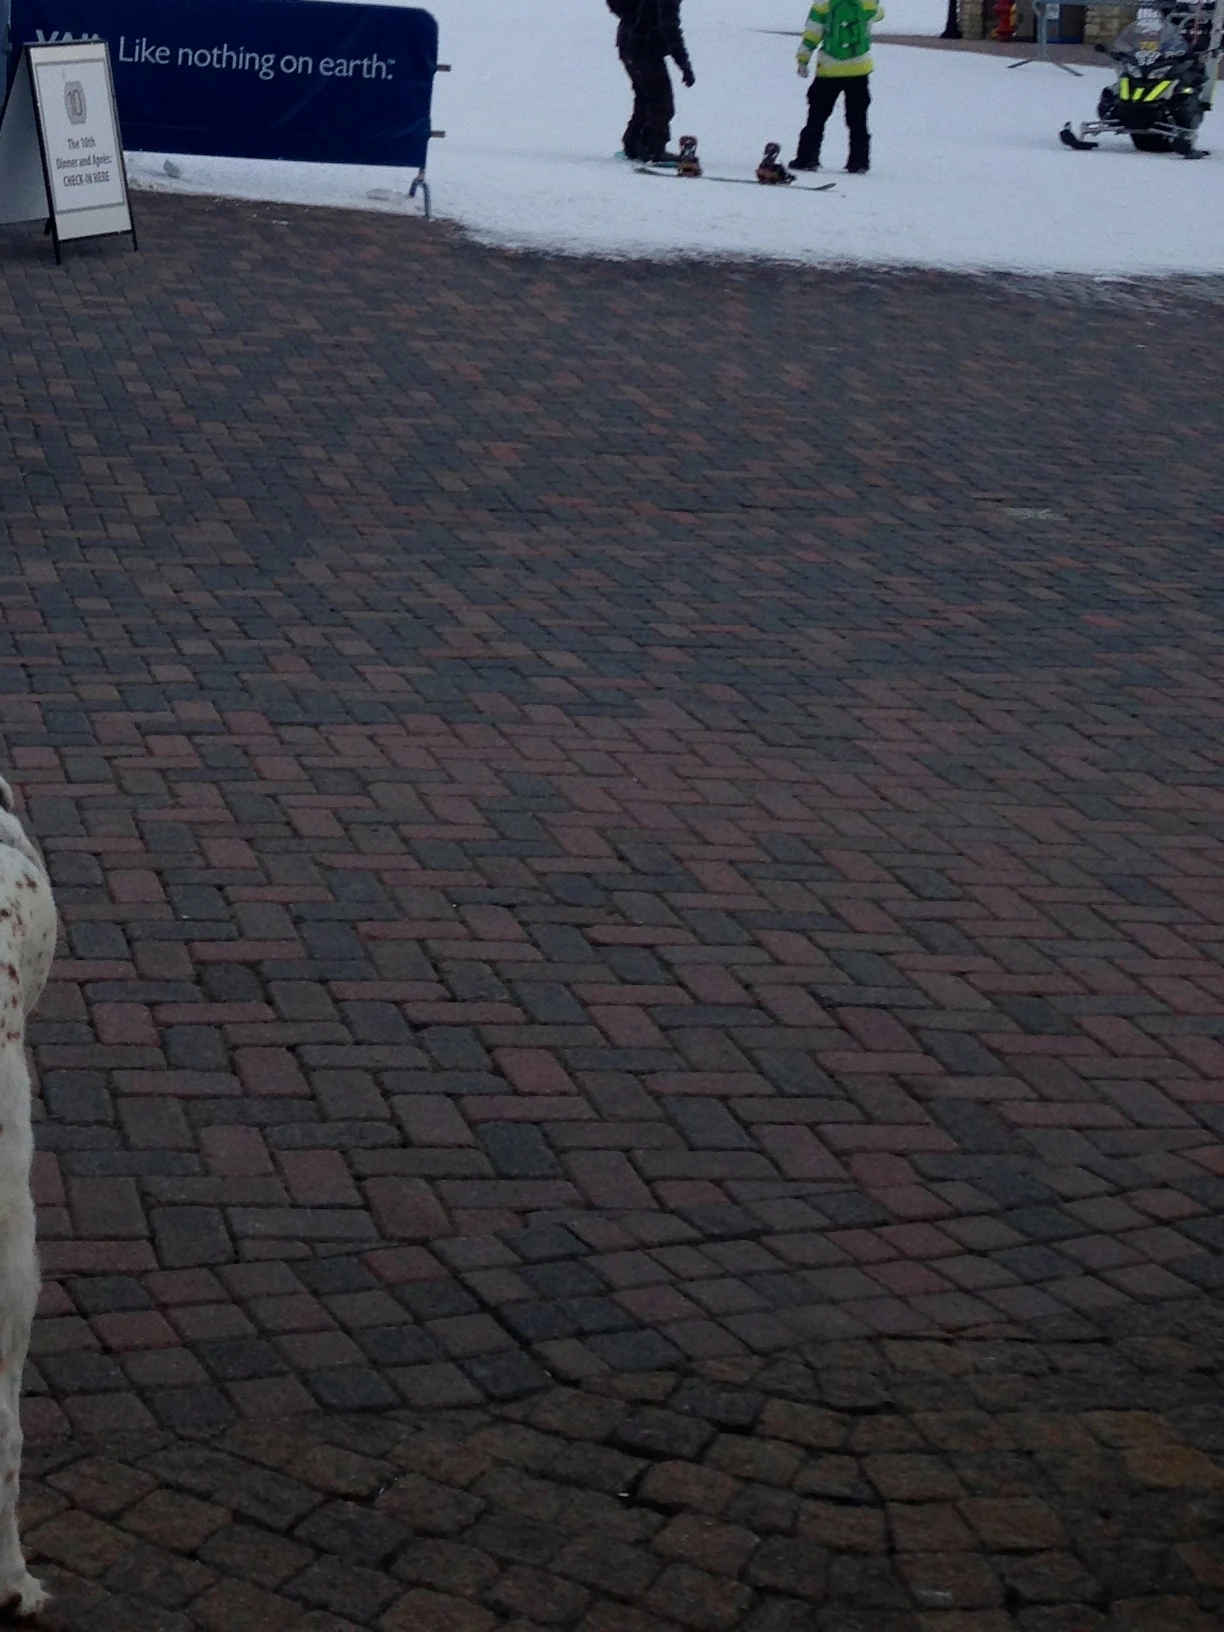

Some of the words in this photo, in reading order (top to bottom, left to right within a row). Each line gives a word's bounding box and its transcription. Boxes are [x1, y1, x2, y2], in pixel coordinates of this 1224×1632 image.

[118, 36, 170, 65] Like
[178, 43, 275, 80] nothing
[280, 54, 313, 75] on
[67, 88, 83, 117] 10
[67, 138, 80, 149] The
[56, 156, 77, 169] Dinner
[79, 155, 91, 167] and
